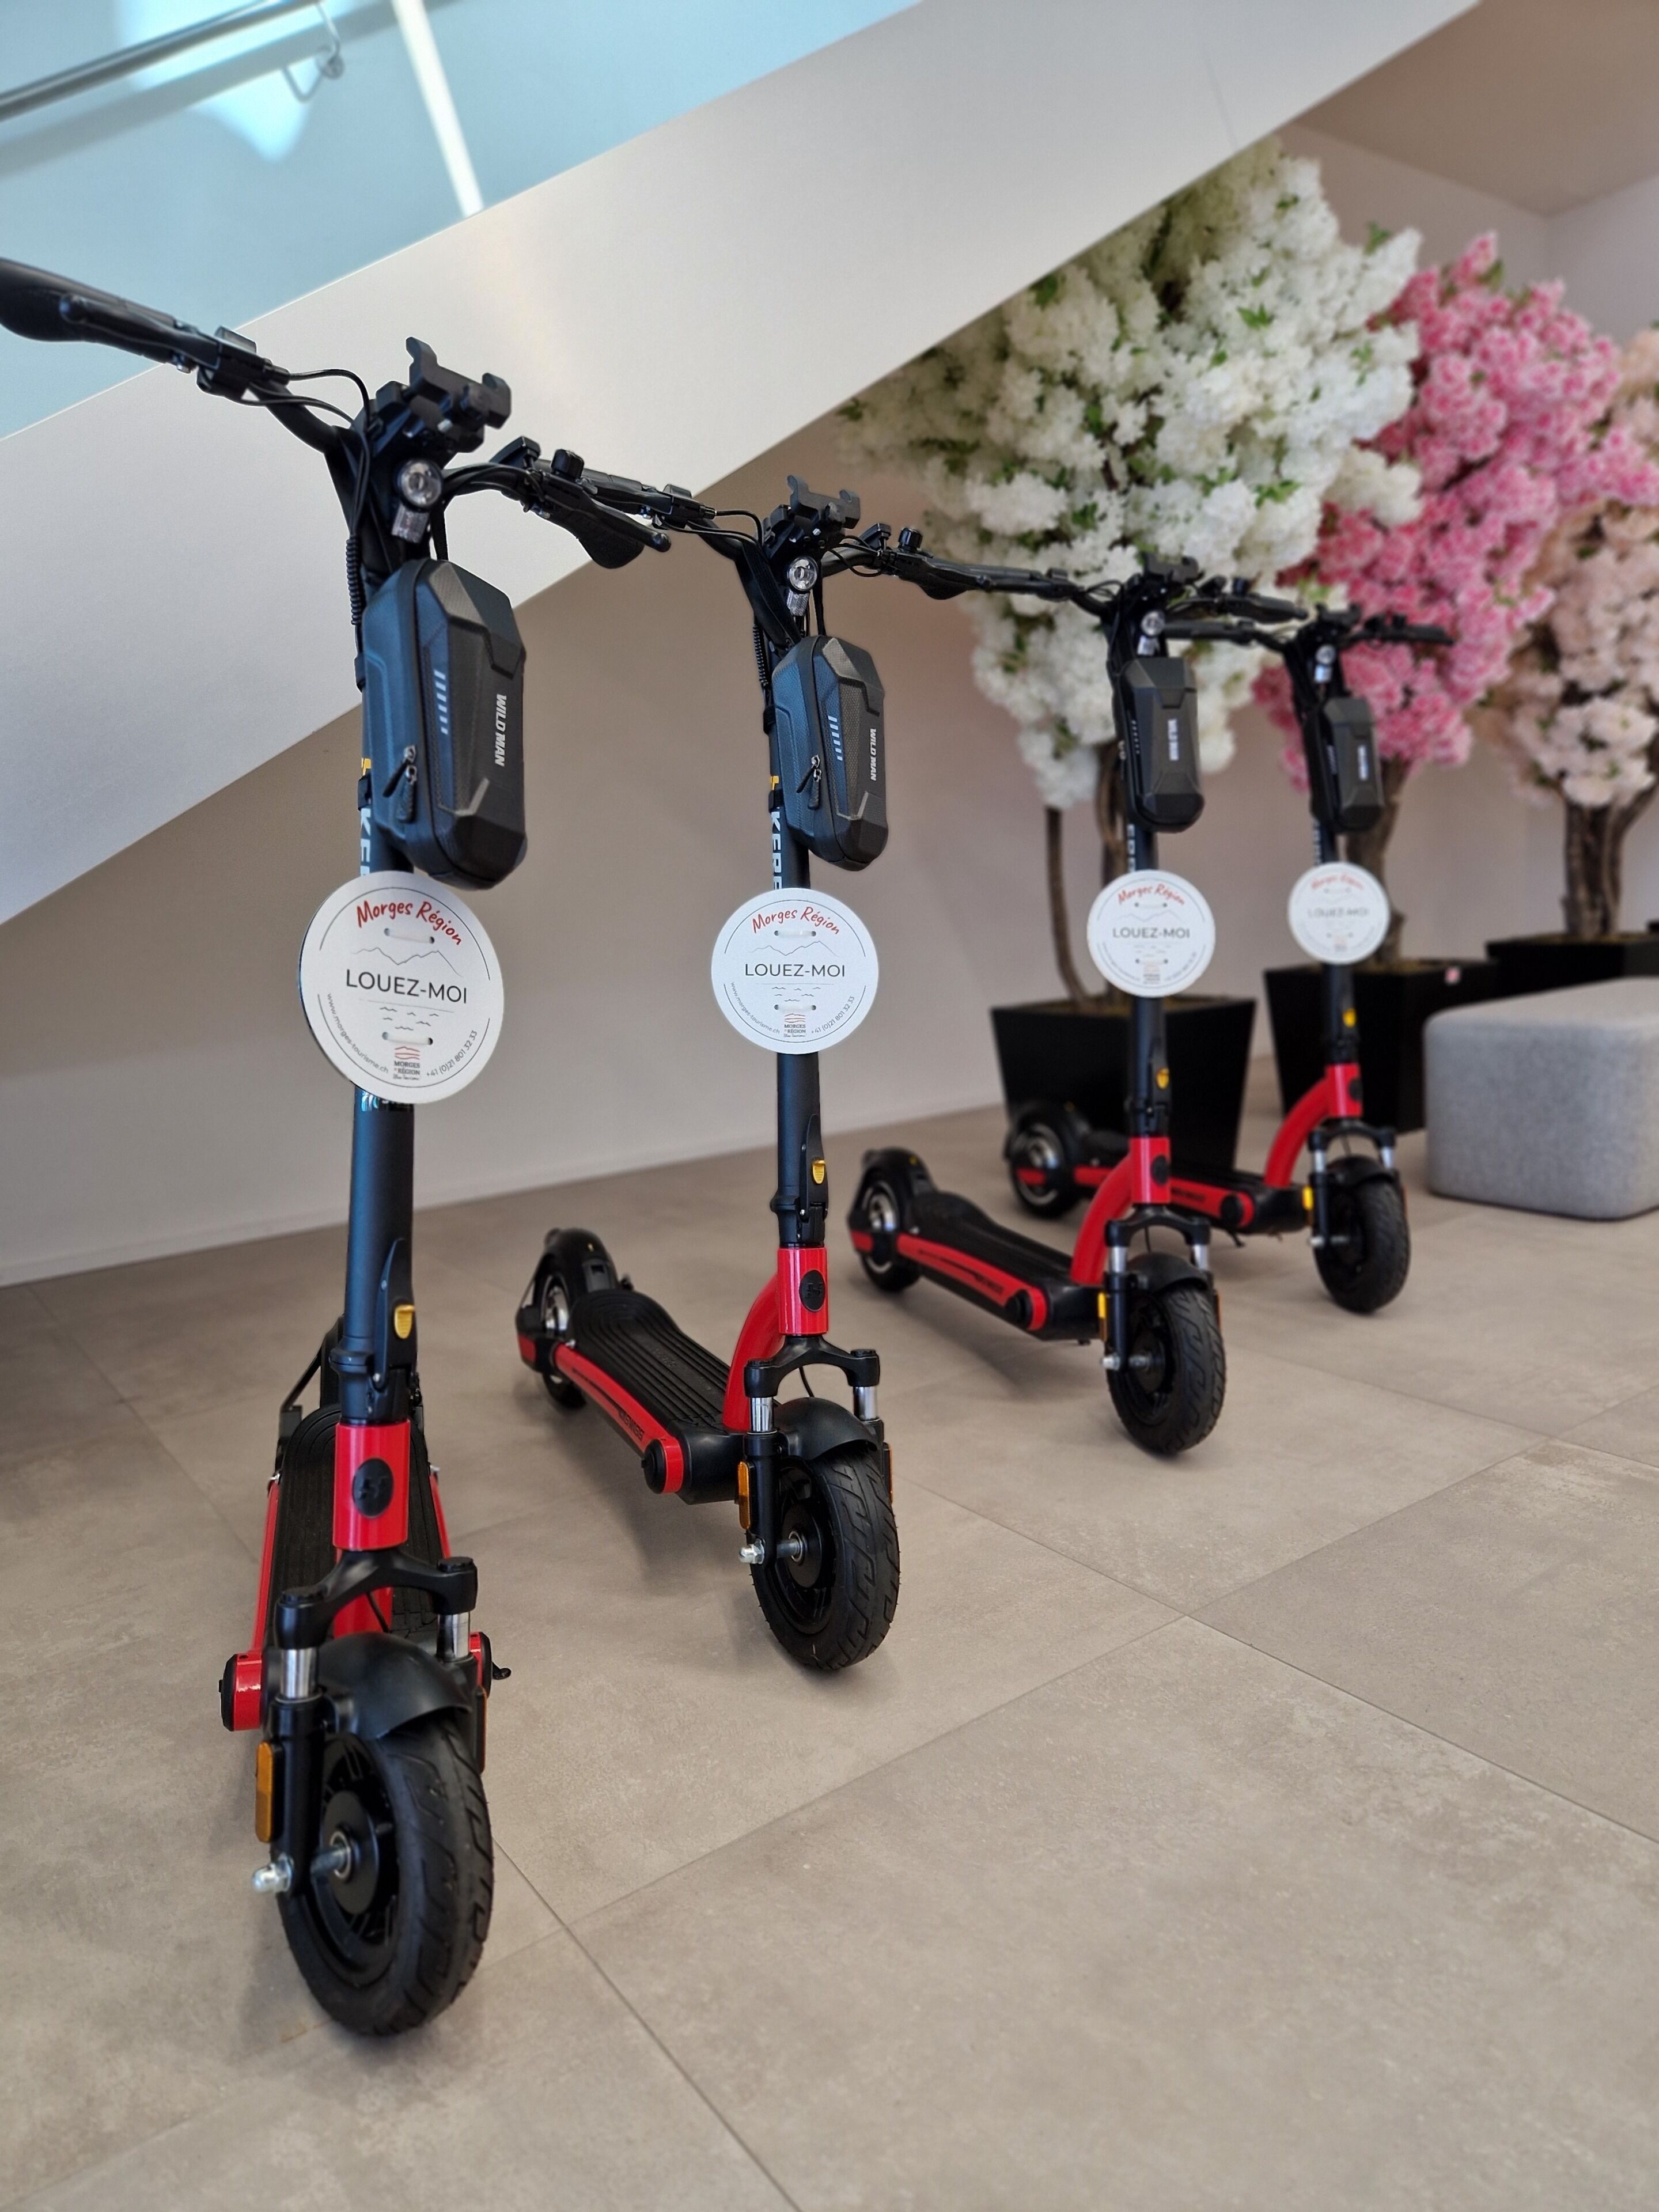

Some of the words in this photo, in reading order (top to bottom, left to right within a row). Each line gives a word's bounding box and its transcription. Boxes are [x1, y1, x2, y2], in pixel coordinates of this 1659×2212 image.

[496, 694, 507, 732] WILD
[495, 732, 506, 767] MAN
[357, 900, 413, 928] Morges
[416, 901, 461, 945] Région
[752, 910, 798, 934] Morges
[800, 906, 840, 935] Région
[1112, 926, 1190, 939] LOUEZ-MOI
[346, 969, 467, 1004] LOUEZ-MOI
[745, 963, 846, 978] LOUEZ-MOI
[730, 982, 780, 1034] www.morges-tourisme.ch
[821, 1019, 836, 1031] (0)21
[835, 1010, 845, 1021] 801
[843, 1003, 850, 1012] 32
[847, 996, 855, 1004] 33
[327, 993, 389, 1074] www.morges-tourisme.ch
[426, 1069, 439, 1077] +41
[439, 1059, 456, 1074] (0)21
[454, 1049, 466, 1062] 801
[463, 1040, 473, 1051] 32
[469, 1030, 478, 1041] 33
